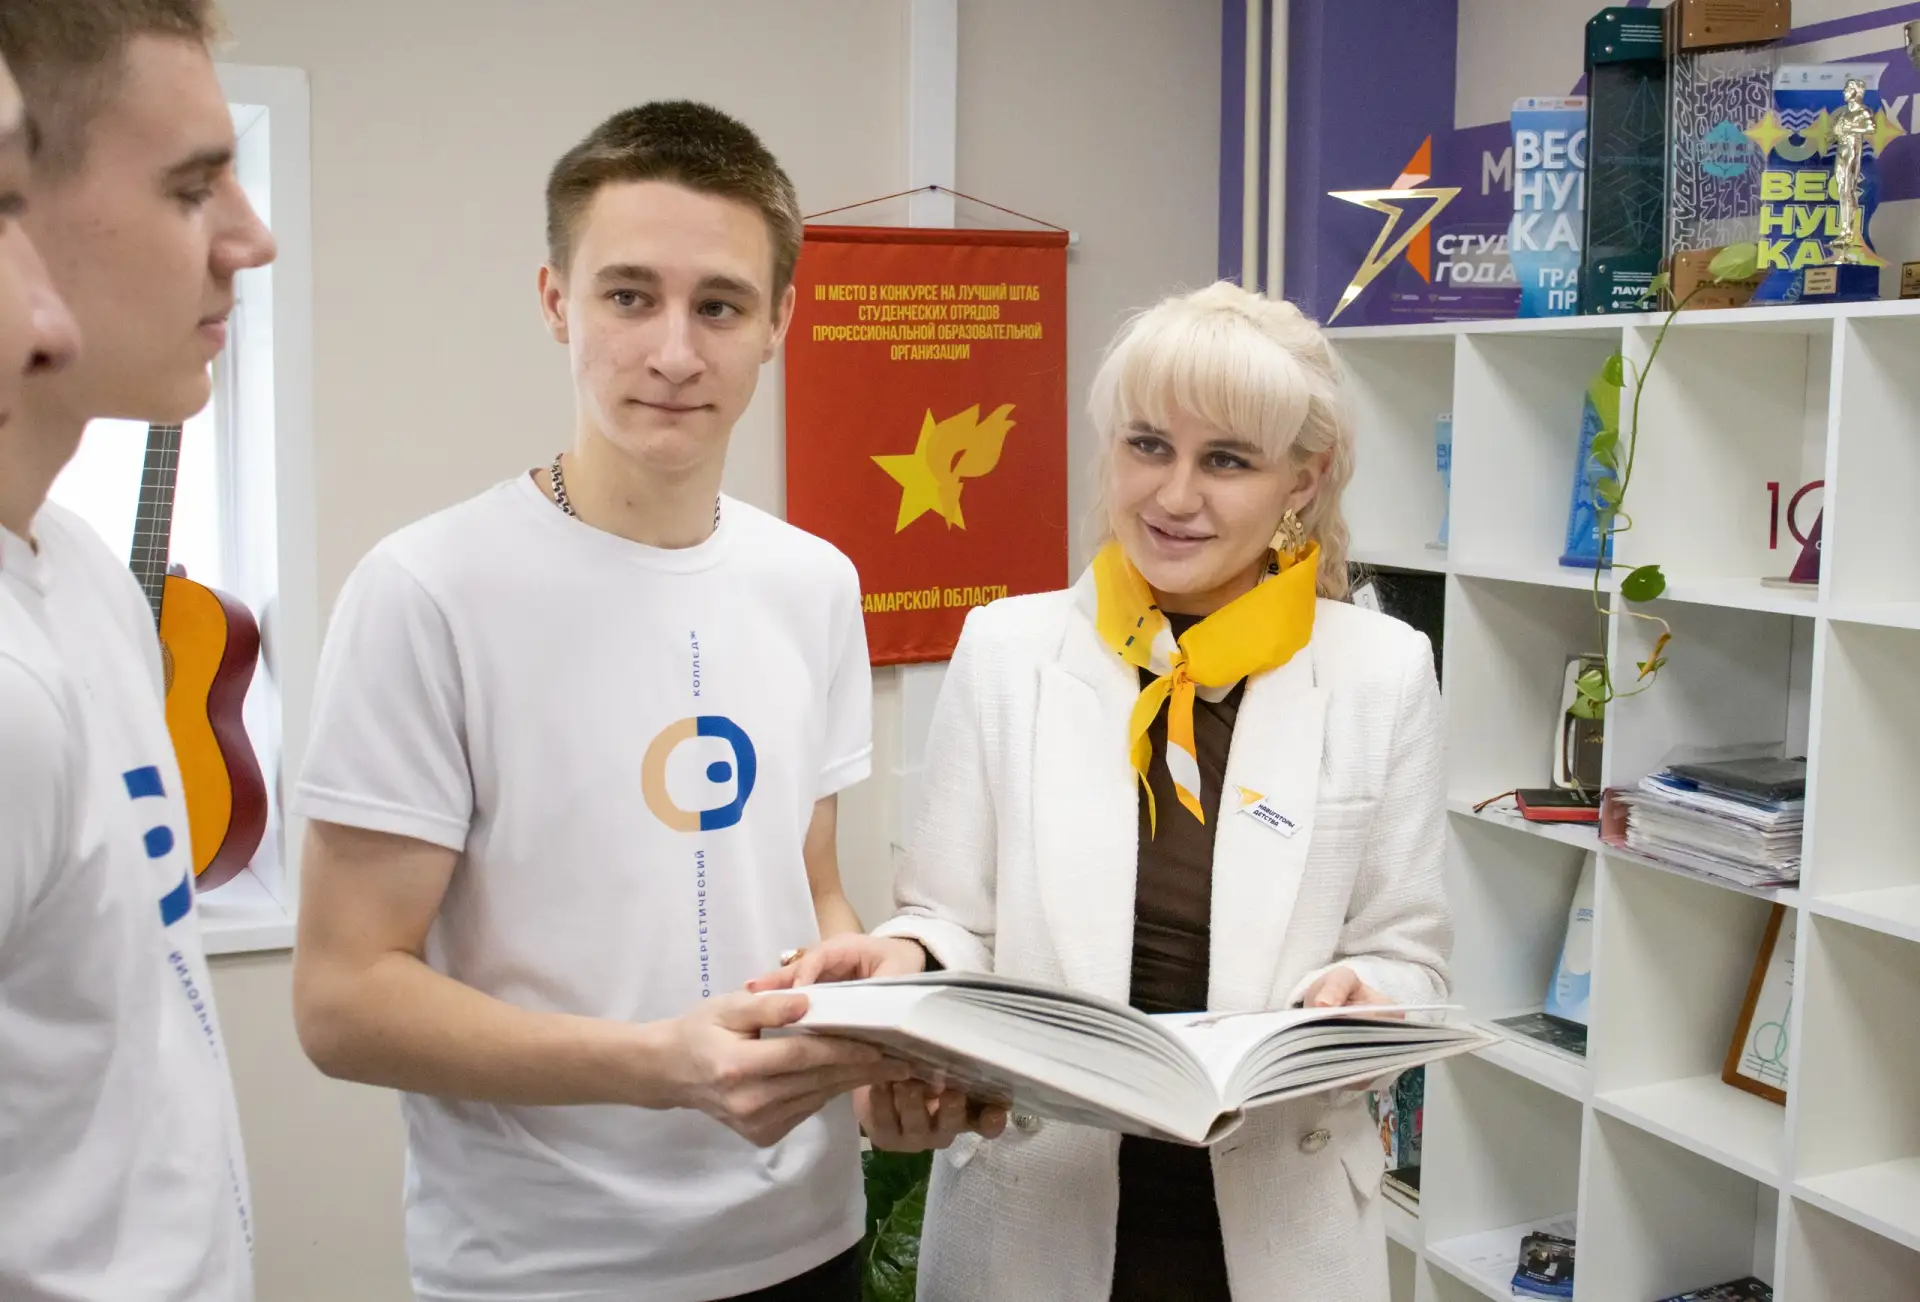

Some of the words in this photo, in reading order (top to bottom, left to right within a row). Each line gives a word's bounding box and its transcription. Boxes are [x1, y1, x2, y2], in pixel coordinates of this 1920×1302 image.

[1514, 172, 1585, 211] НУ
[1513, 212, 1581, 252] КА
[1756, 238, 1826, 270] КА
[1435, 262, 1520, 284] ГОДА
[828, 285, 867, 300] МЕСТО
[870, 285, 877, 300] В
[880, 285, 938, 300] КОНКУРСЕ
[941, 284, 956, 300] НА
[958, 283, 1007, 300] ЛУЧШИЙ
[1009, 286, 1040, 300] ШТАБ
[1611, 286, 1658, 296] ЛАУР
[858, 304, 948, 321] СТУДЕНЧЕСКИХ
[950, 304, 1000, 321] ОТРЯДОВ
[812, 323, 935, 341] ПРОФЕССИОНАЛЬНОЙ
[938, 323, 1043, 340] ОБРАЗОВАТЕЛЬНОЙ
[890, 343, 970, 361] ОРГАНИЗАЦИИ
[861, 586, 940, 613] АМАРСКОЙ
[943, 585, 1008, 608] ОБЛАСТИ
[690, 630, 701, 697] КОЛЛЕДЖ
[1252, 809, 1279, 827] ДЕТСТВА
[1258, 803, 1295, 828] НАВИГАТОРЫ
